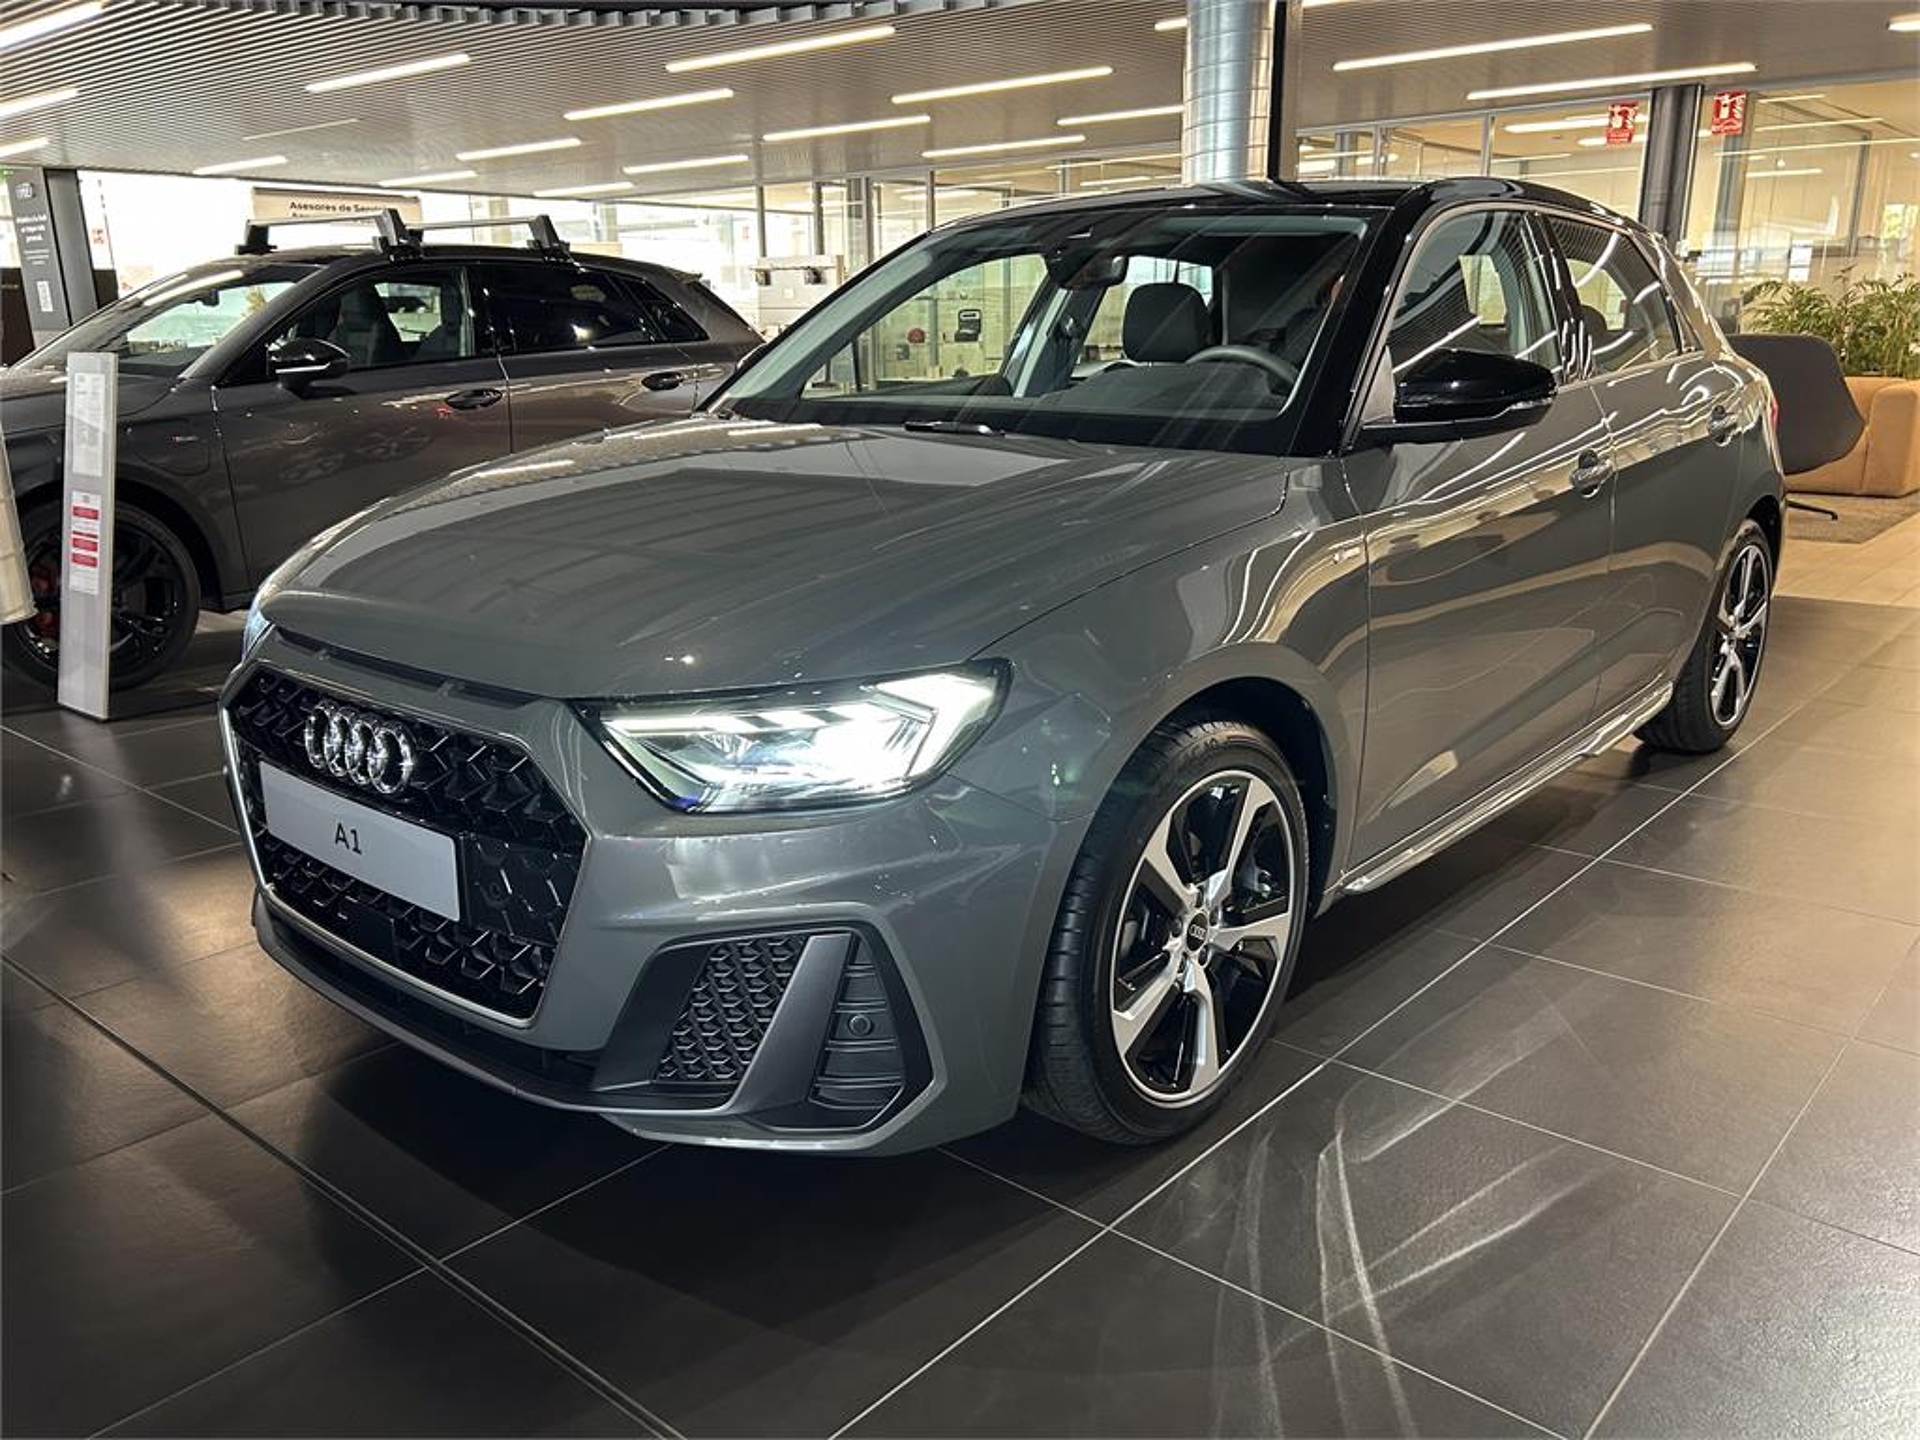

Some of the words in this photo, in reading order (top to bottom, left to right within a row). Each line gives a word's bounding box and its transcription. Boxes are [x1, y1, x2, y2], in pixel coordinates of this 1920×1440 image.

[290, 201, 336, 211] Asesores
[339, 204, 352, 212] de
[335, 822, 362, 855] A1
